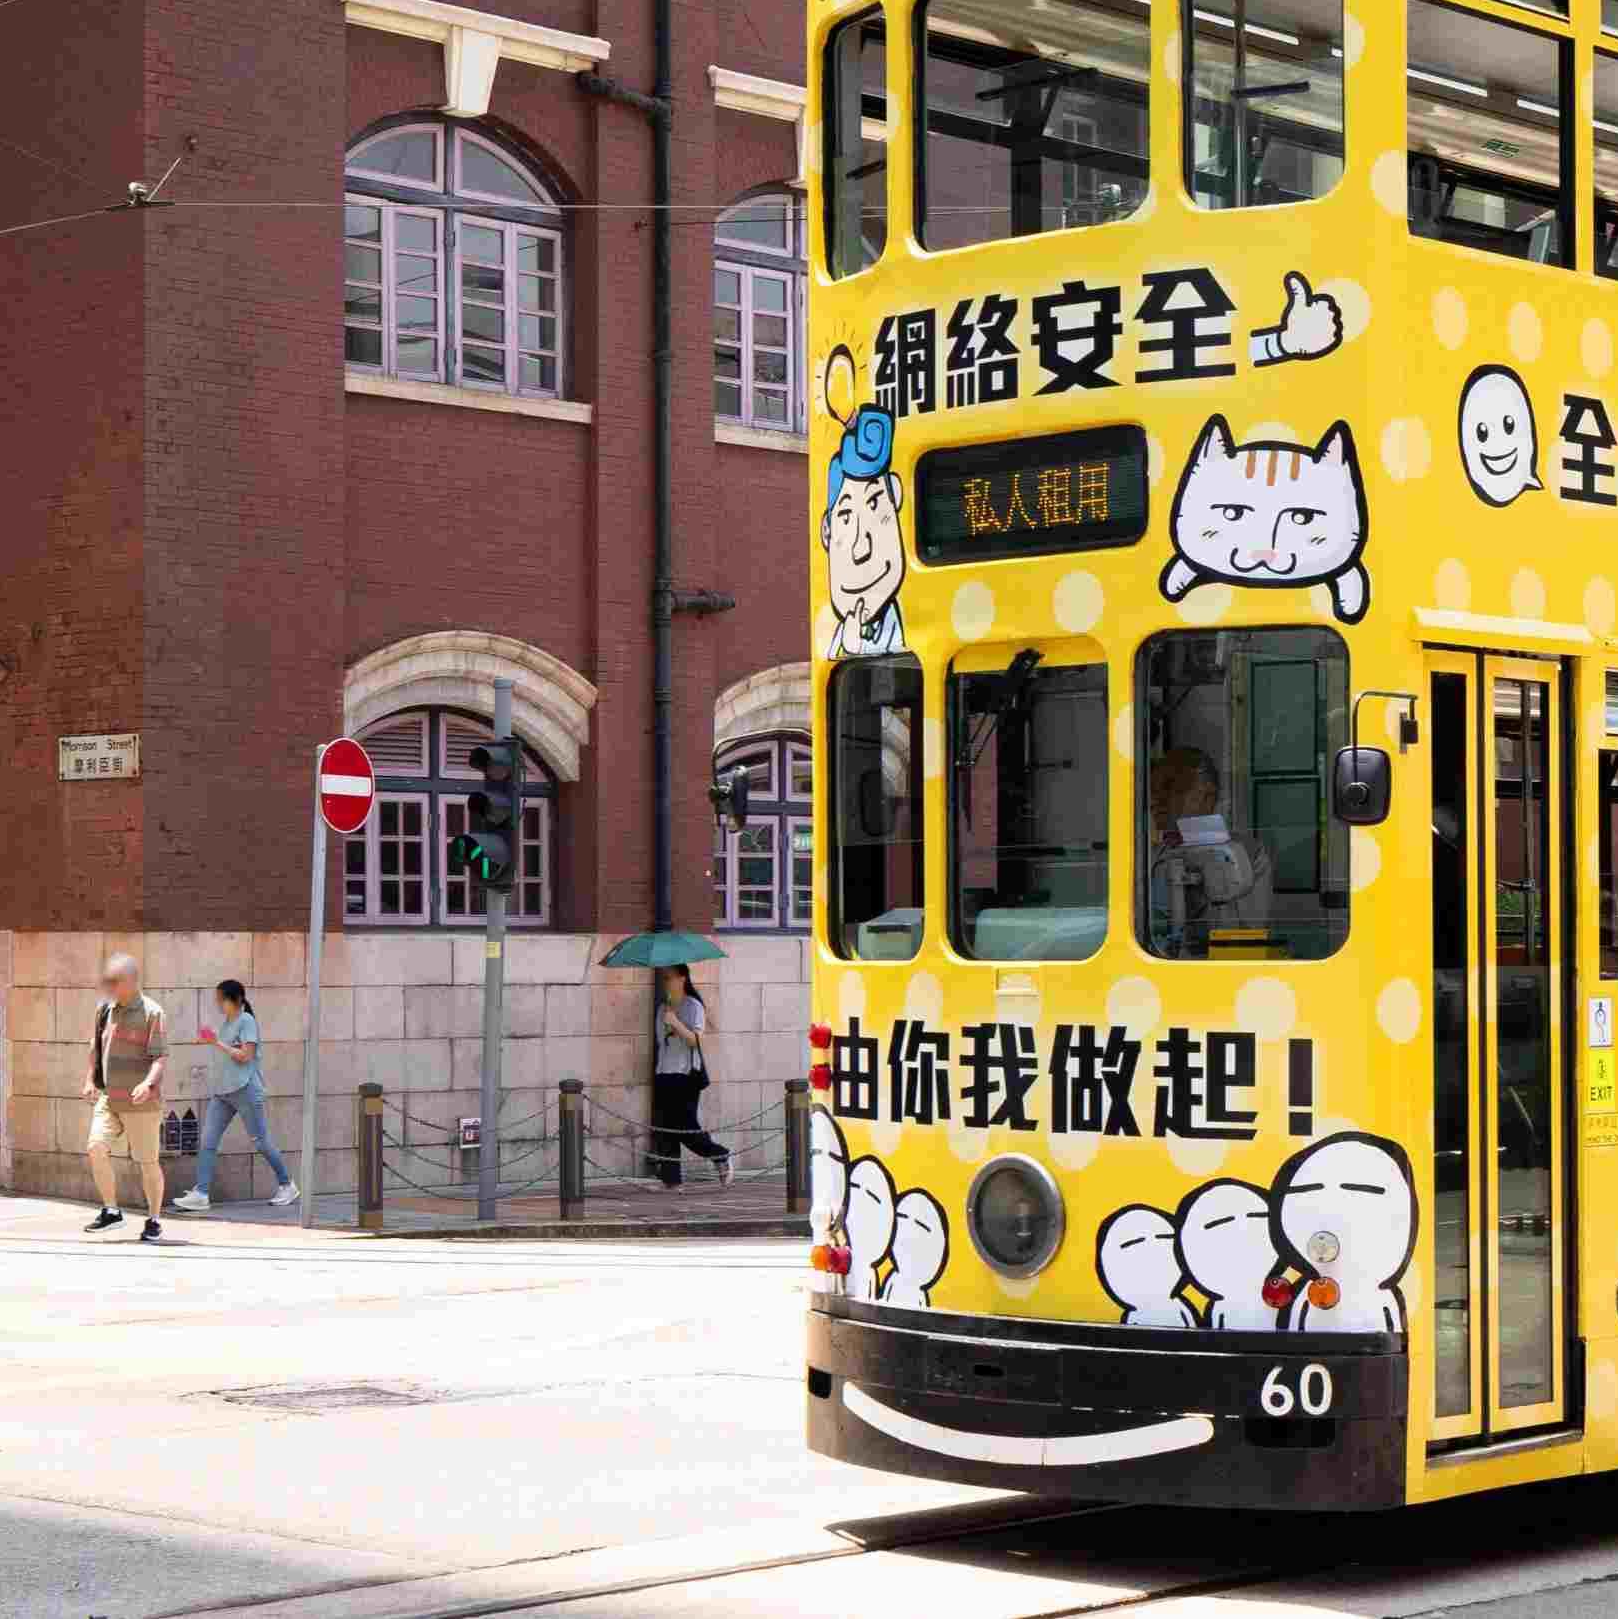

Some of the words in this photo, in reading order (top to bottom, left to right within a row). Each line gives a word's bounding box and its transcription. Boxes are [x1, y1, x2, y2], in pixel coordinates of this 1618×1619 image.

[875, 266, 1237, 418] 網絡安全
[960, 462, 1111, 537] 私人租用
[106, 739, 133, 750] Street
[1590, 1086, 1613, 1101] EXIT
[1261, 1364, 1333, 1418] 60
